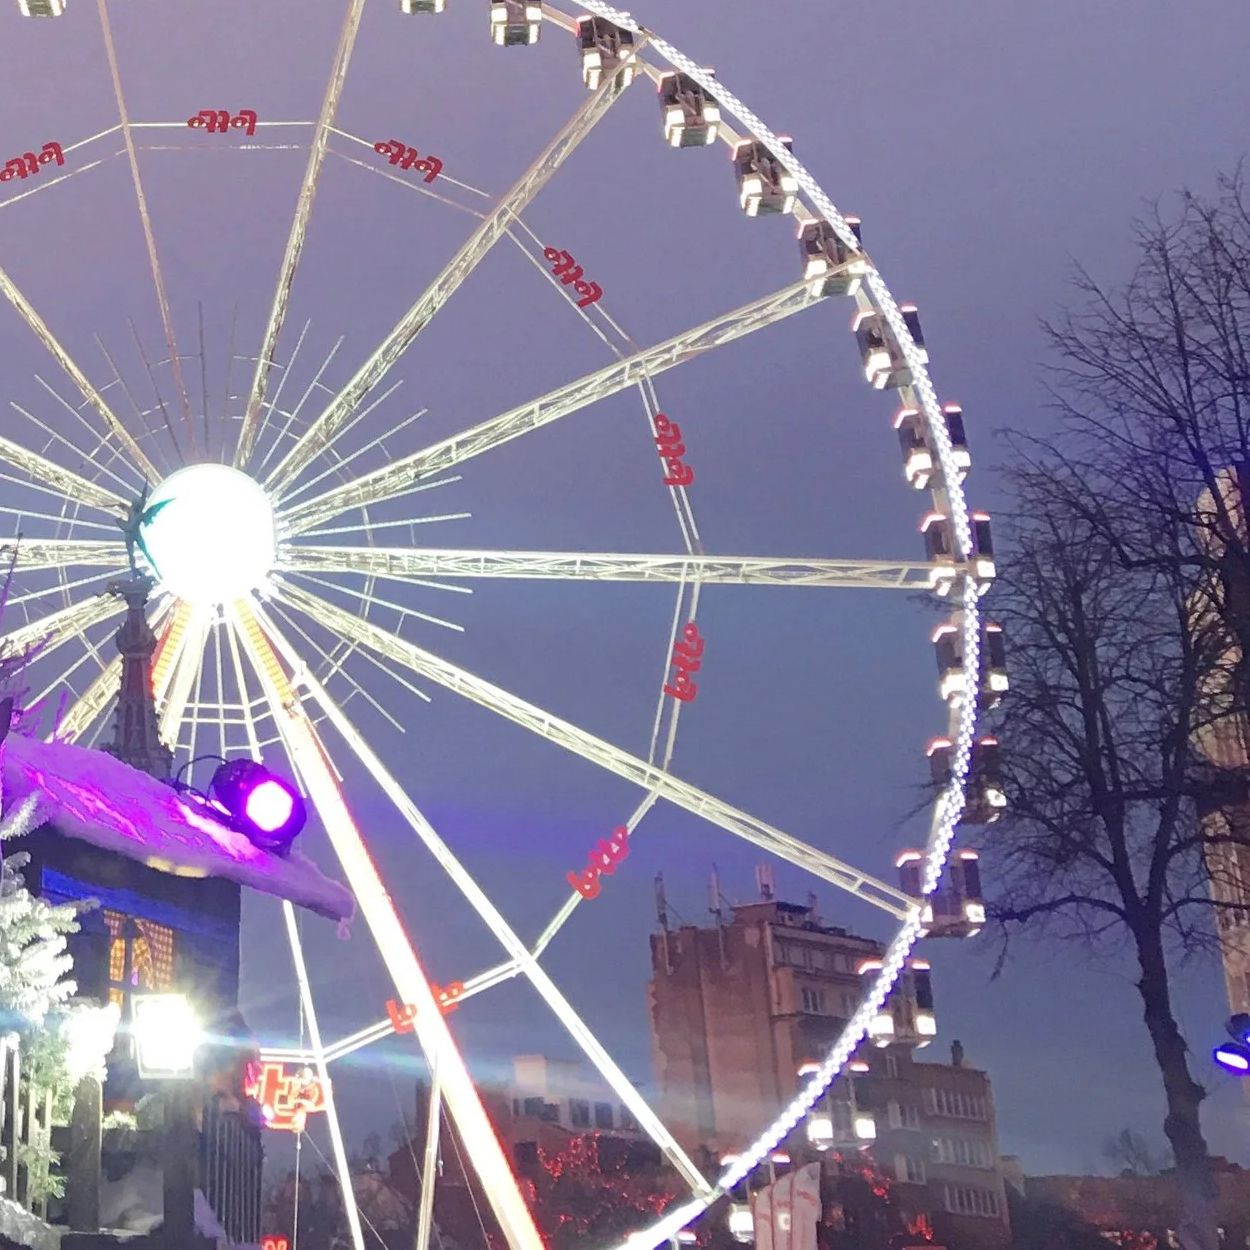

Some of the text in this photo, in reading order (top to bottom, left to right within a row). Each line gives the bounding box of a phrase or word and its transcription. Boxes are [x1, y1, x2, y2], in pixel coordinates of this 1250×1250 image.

[188, 109, 258, 136] Lotto
[373, 139, 443, 184] Lotto
[543, 247, 603, 308] Lotto
